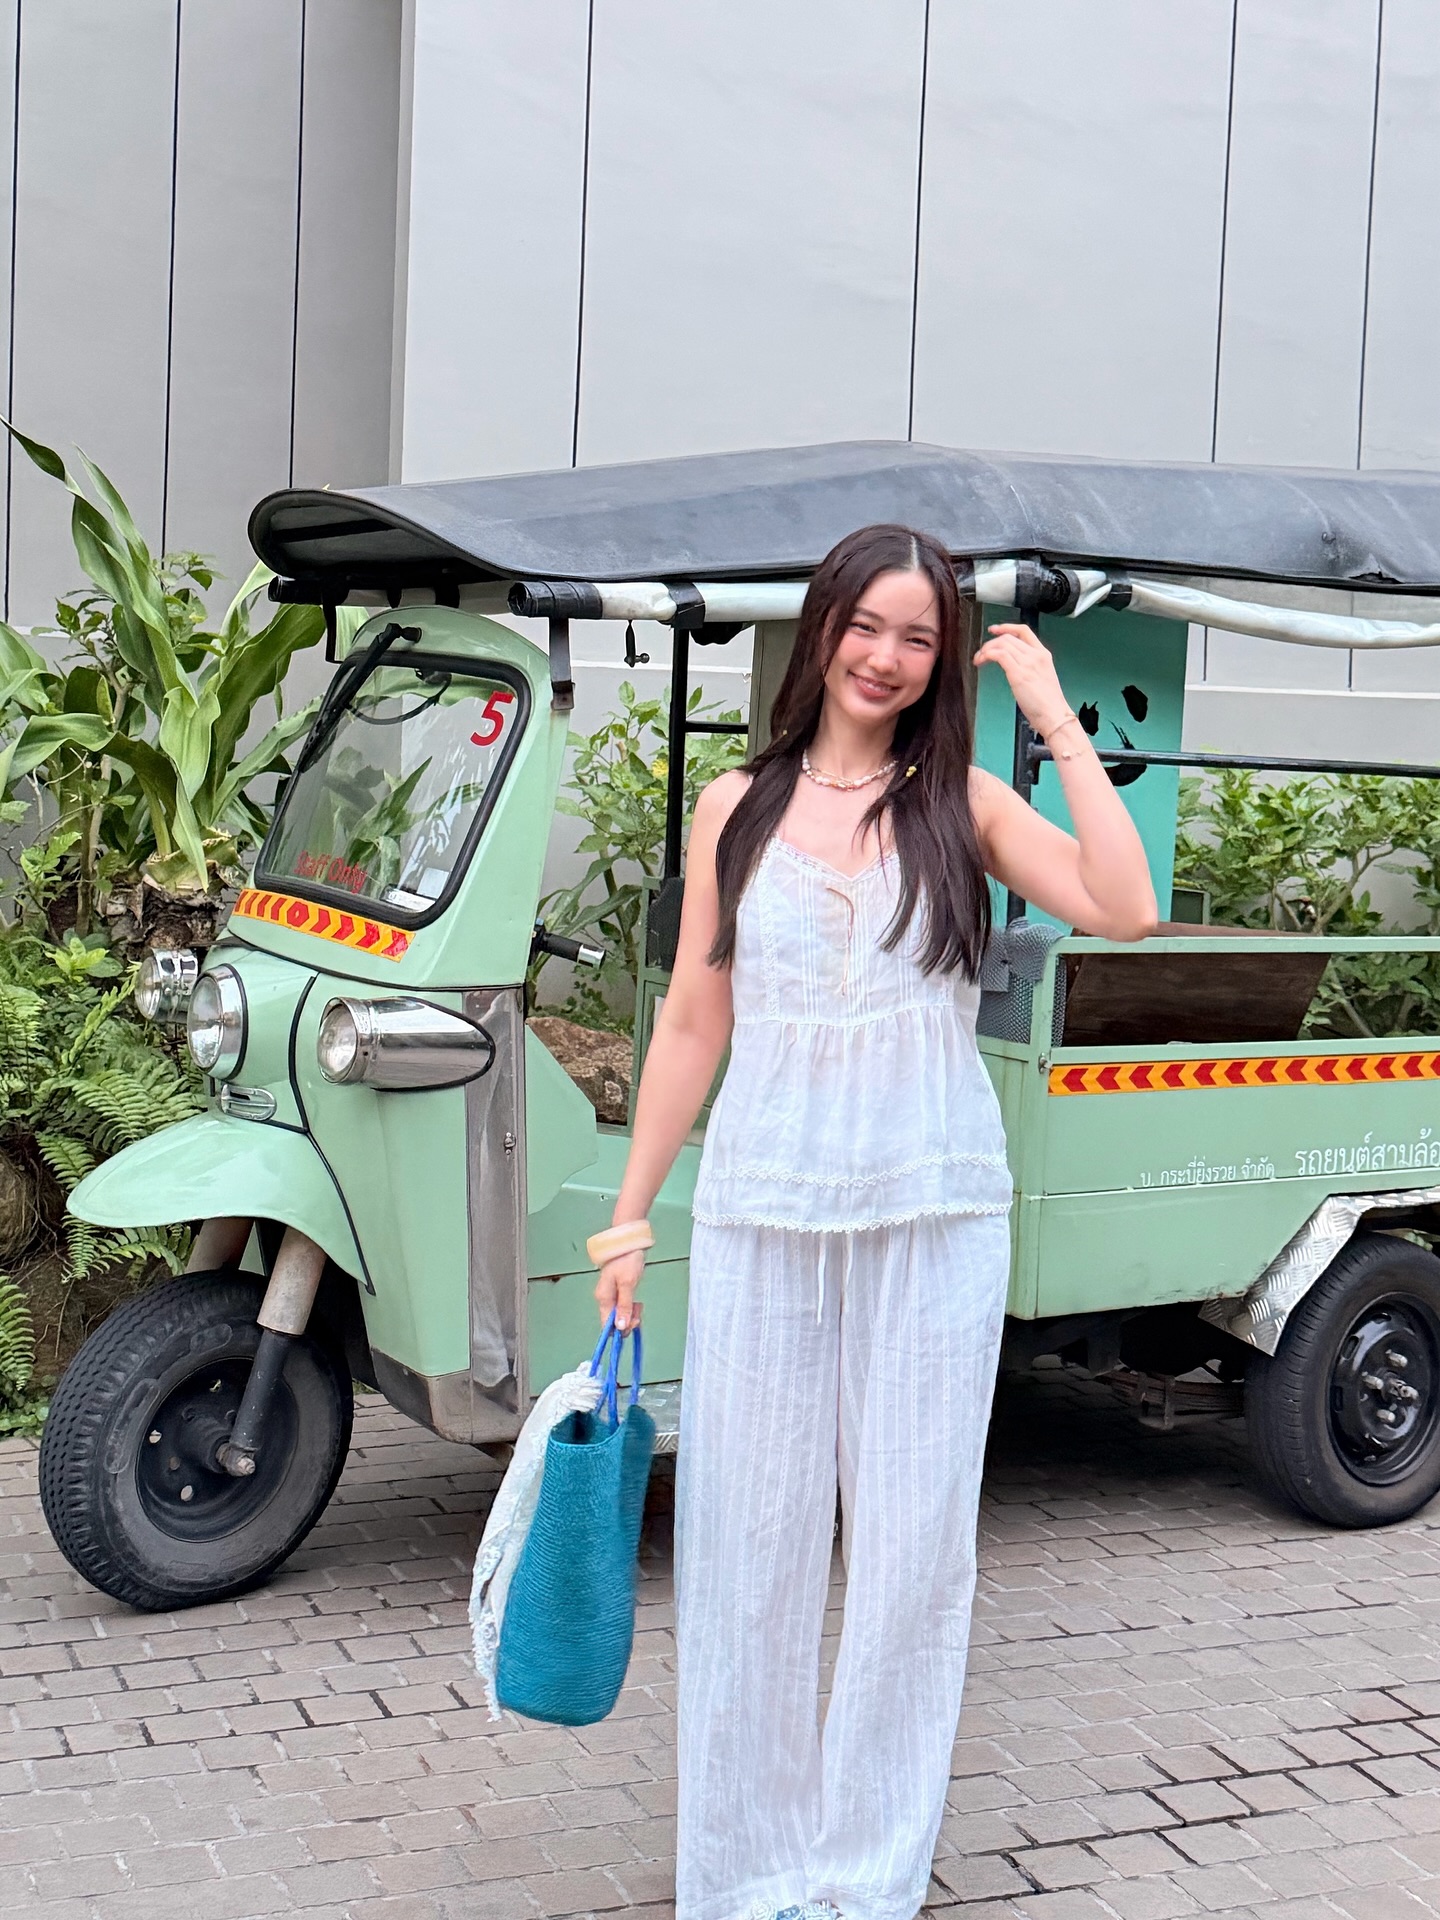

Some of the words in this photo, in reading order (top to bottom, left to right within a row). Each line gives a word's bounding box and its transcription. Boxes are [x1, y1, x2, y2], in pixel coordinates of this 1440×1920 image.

[469, 690, 515, 747] 5
[327, 856, 368, 895] Only
[1241, 1156, 1275, 1180] จำกัด
